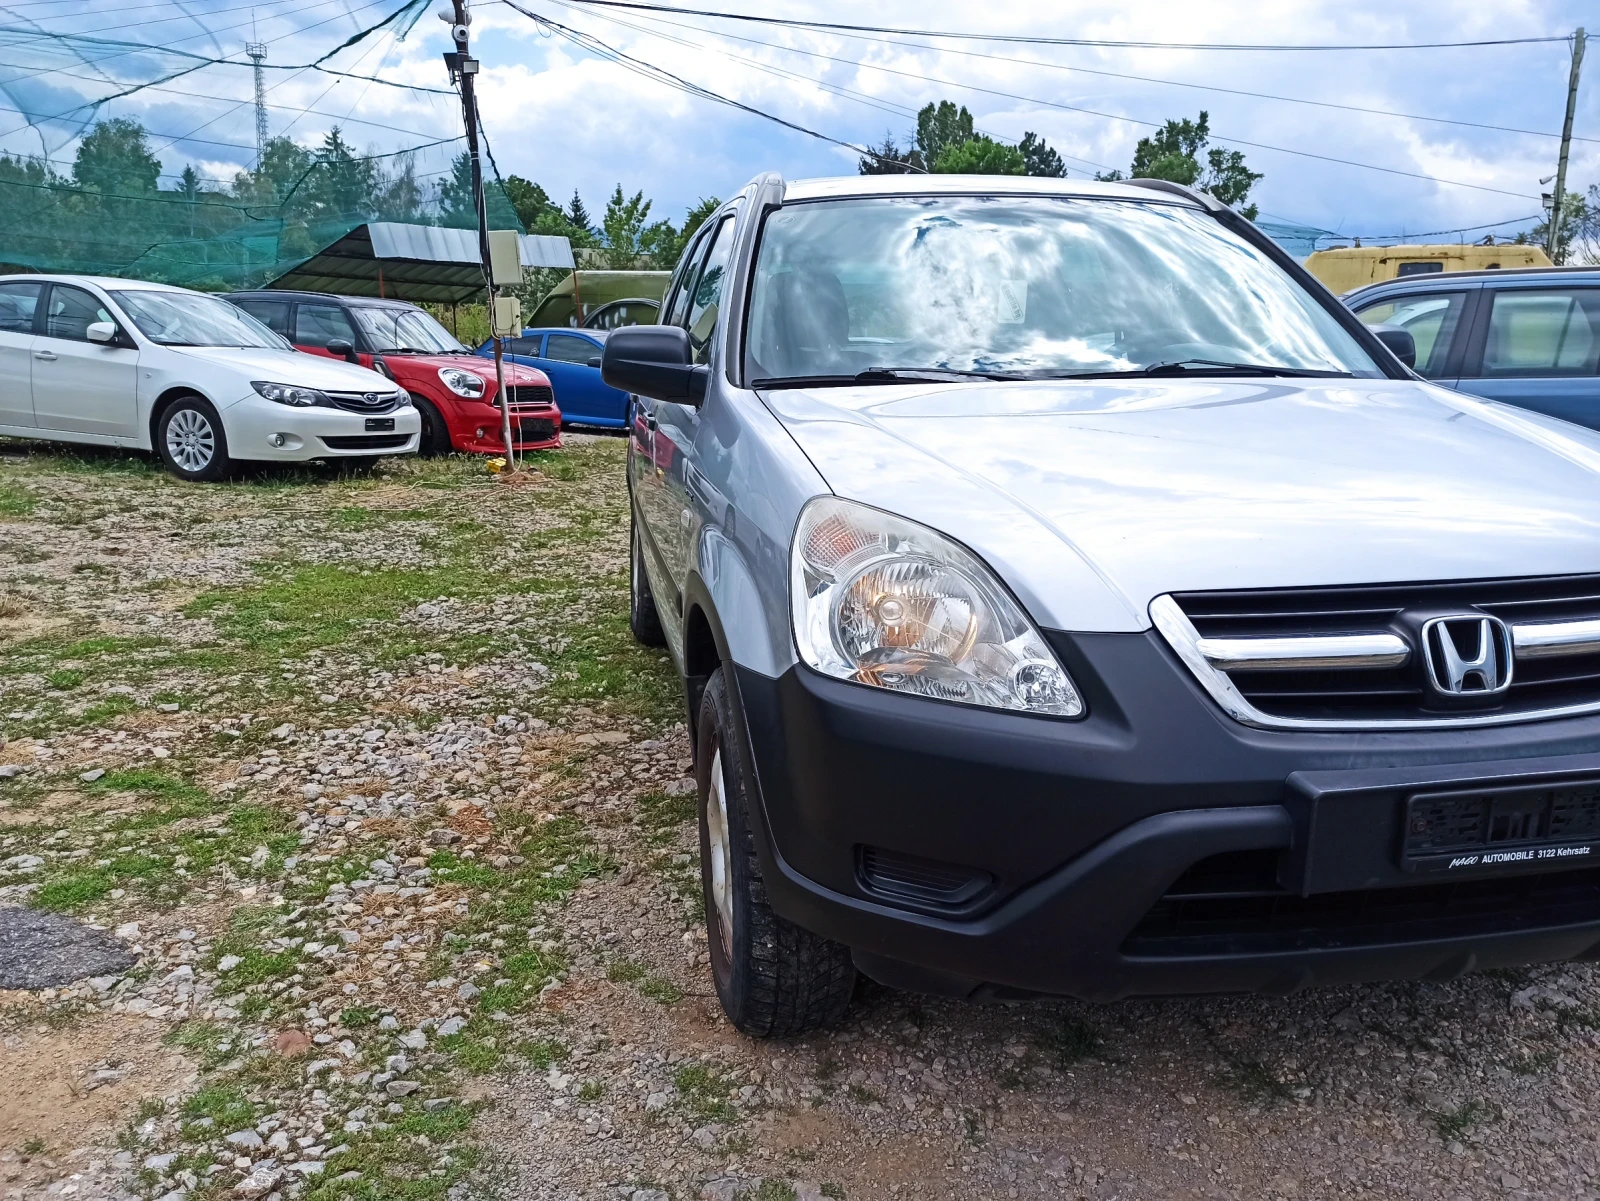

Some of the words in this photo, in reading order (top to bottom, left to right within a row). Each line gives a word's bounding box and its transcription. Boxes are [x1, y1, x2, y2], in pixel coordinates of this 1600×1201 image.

[1482, 850, 1534, 863] AUTOMOBILE
[1538, 849, 1555, 859] 3122
[1557, 846, 1590, 857] Kehrsatz
